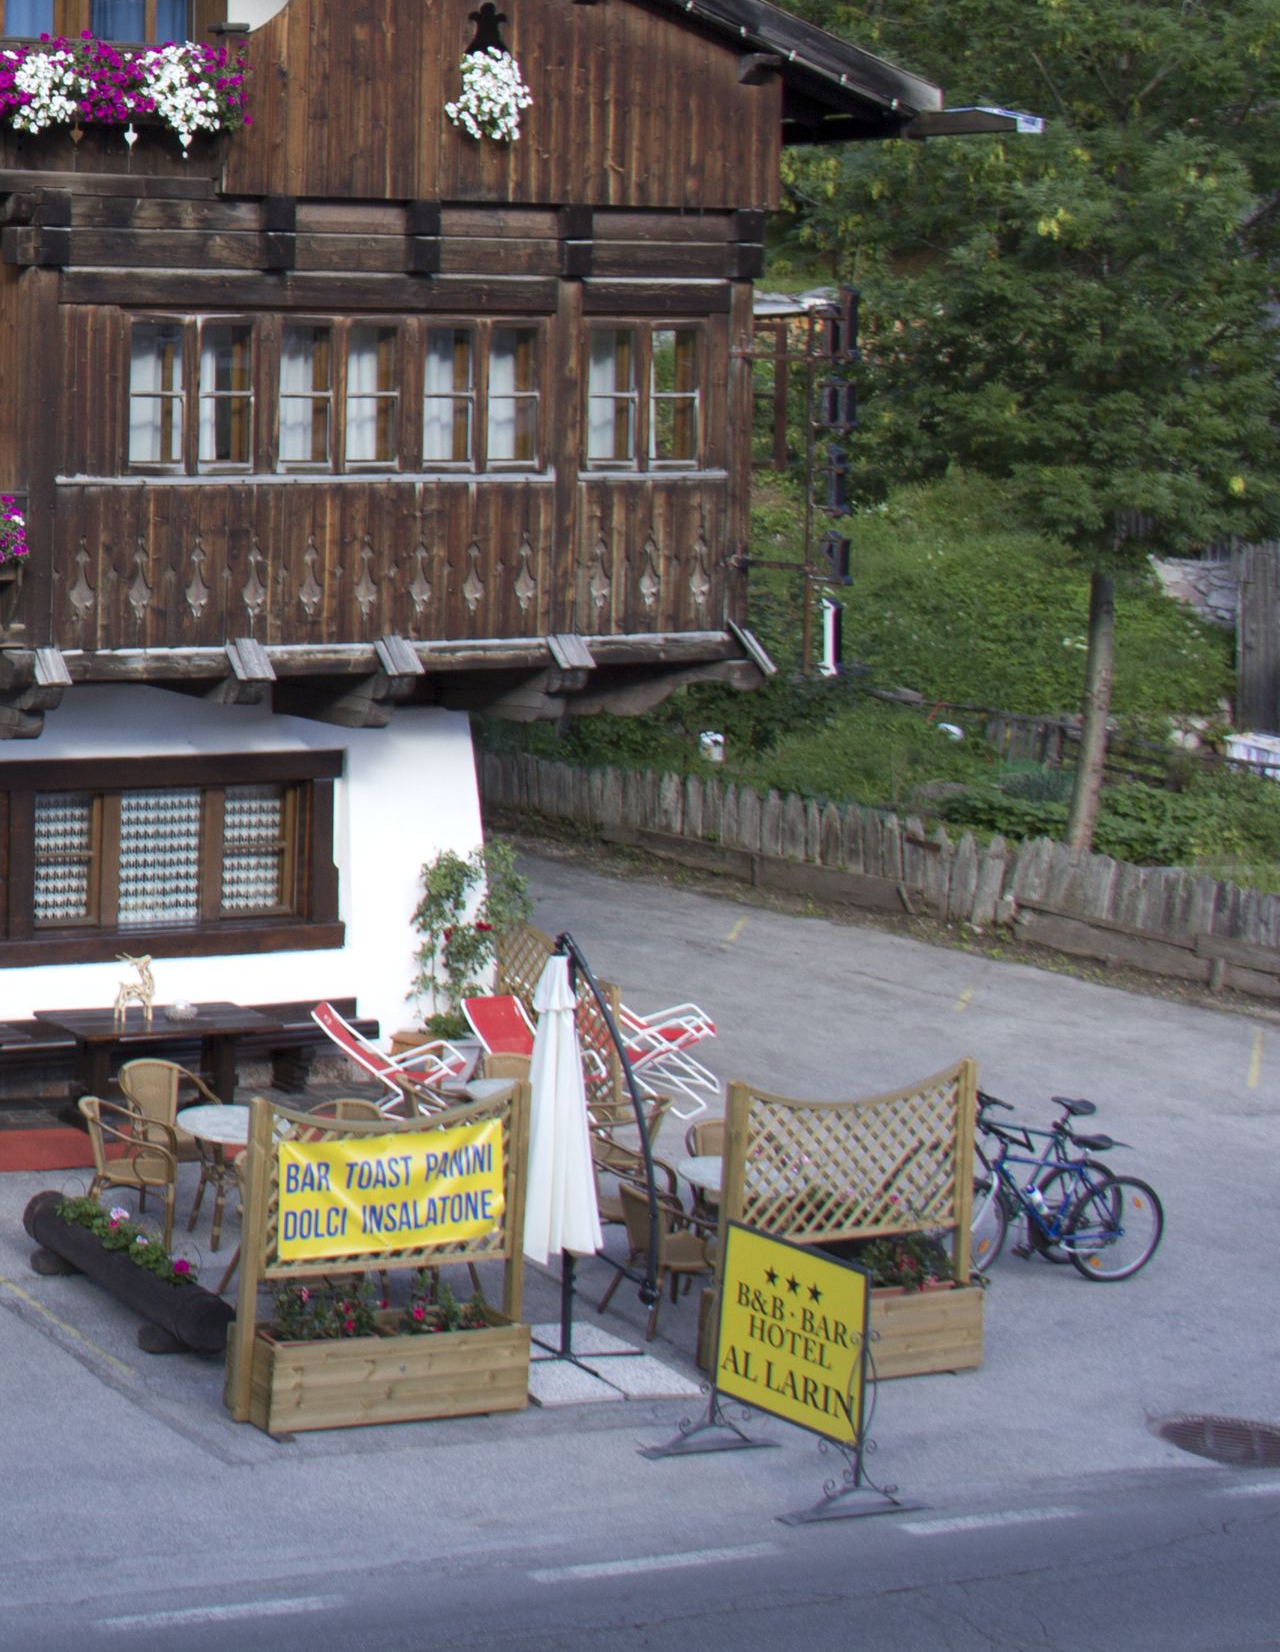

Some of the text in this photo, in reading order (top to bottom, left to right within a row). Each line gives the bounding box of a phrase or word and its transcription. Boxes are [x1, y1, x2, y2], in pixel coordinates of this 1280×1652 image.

[285, 1142, 493, 1194] BAR TOAST PANINI
[283, 1189, 494, 1241] DOLCI INSALATONE
[737, 1280, 849, 1350] B&B BAR
[748, 1314, 832, 1371] HOTEL
[720, 1344, 855, 1421] AL LARIN
